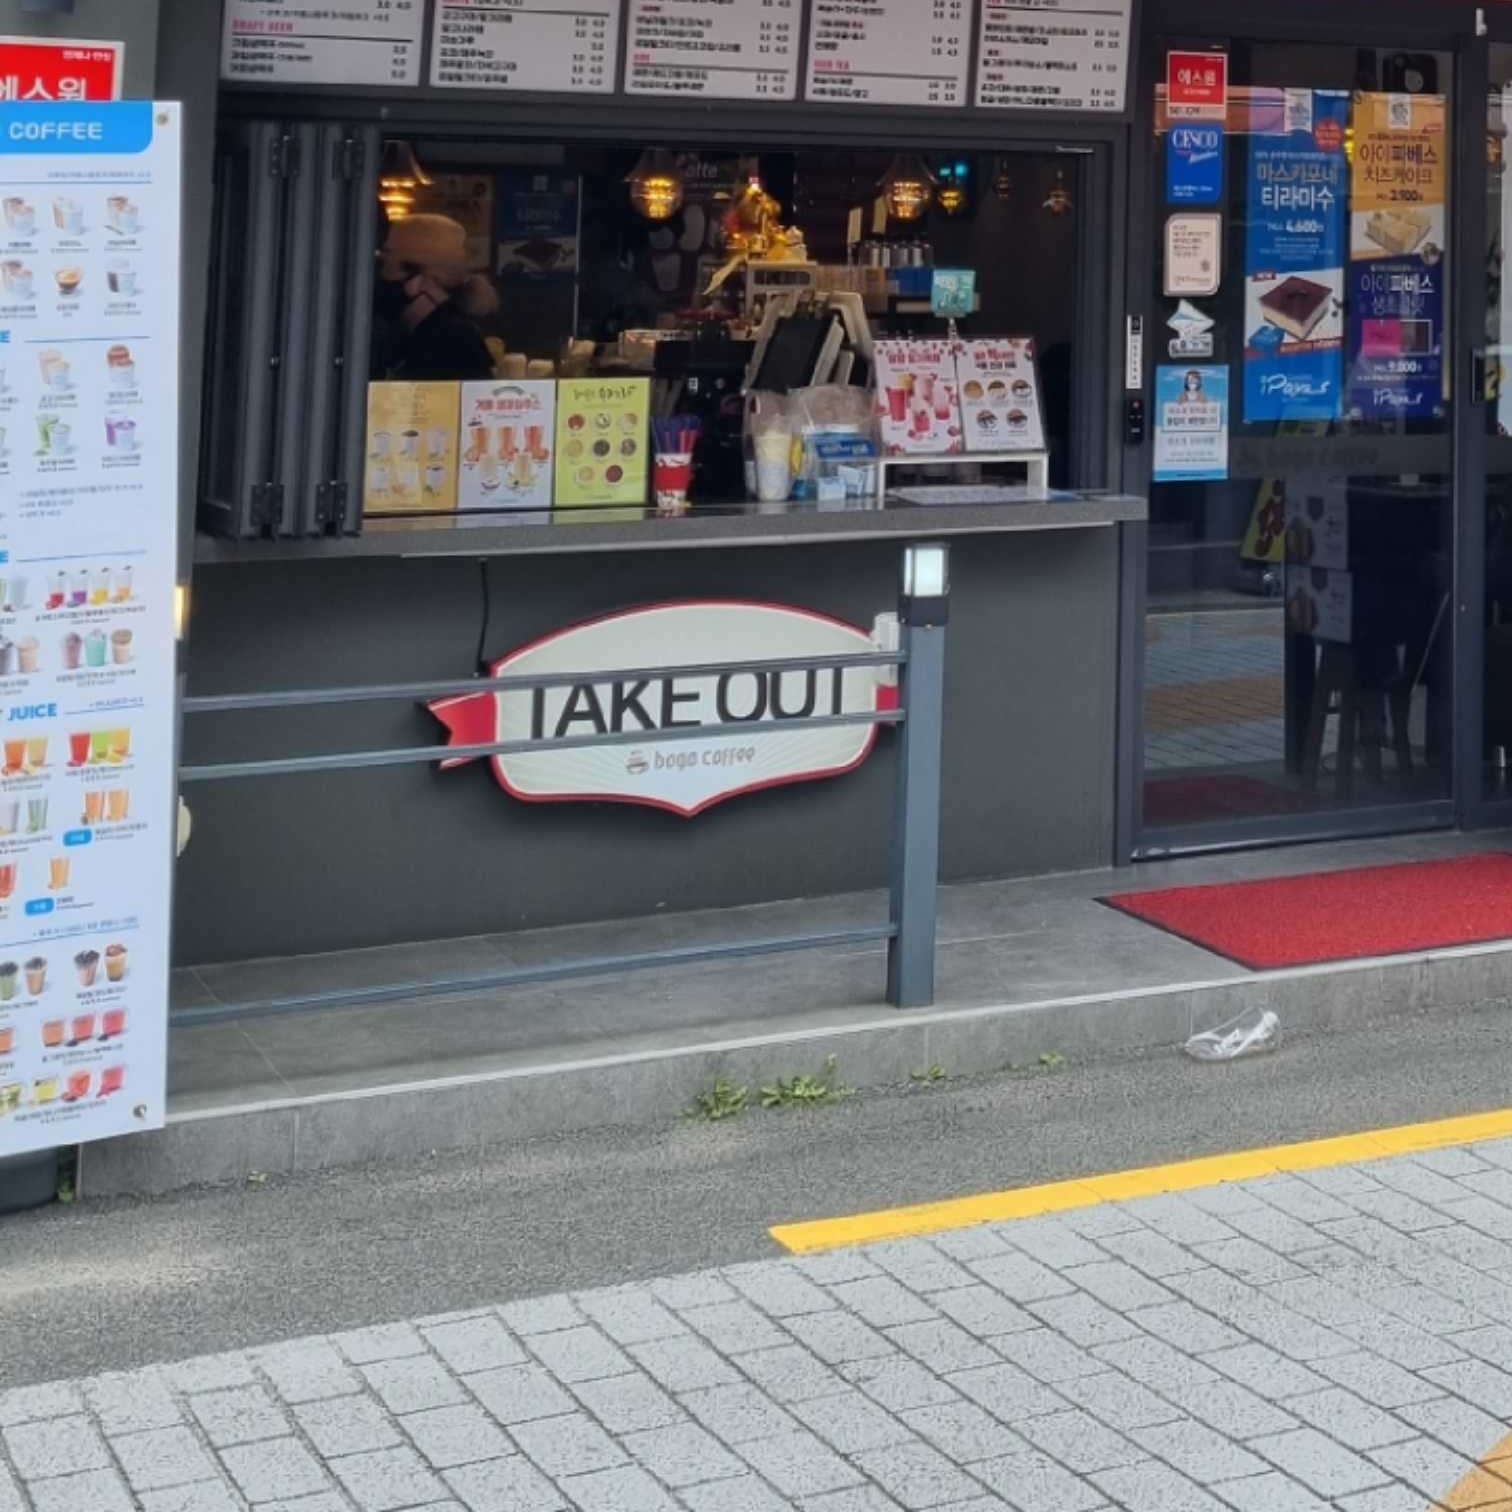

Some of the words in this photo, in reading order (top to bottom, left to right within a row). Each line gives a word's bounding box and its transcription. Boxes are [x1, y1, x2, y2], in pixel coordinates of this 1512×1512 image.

[8, 121, 104, 141] COFFEE
[1261, 184, 1335, 211] 티라미수
[7, 702, 58, 722] JUICE
[653, 752, 698, 770] bogo
